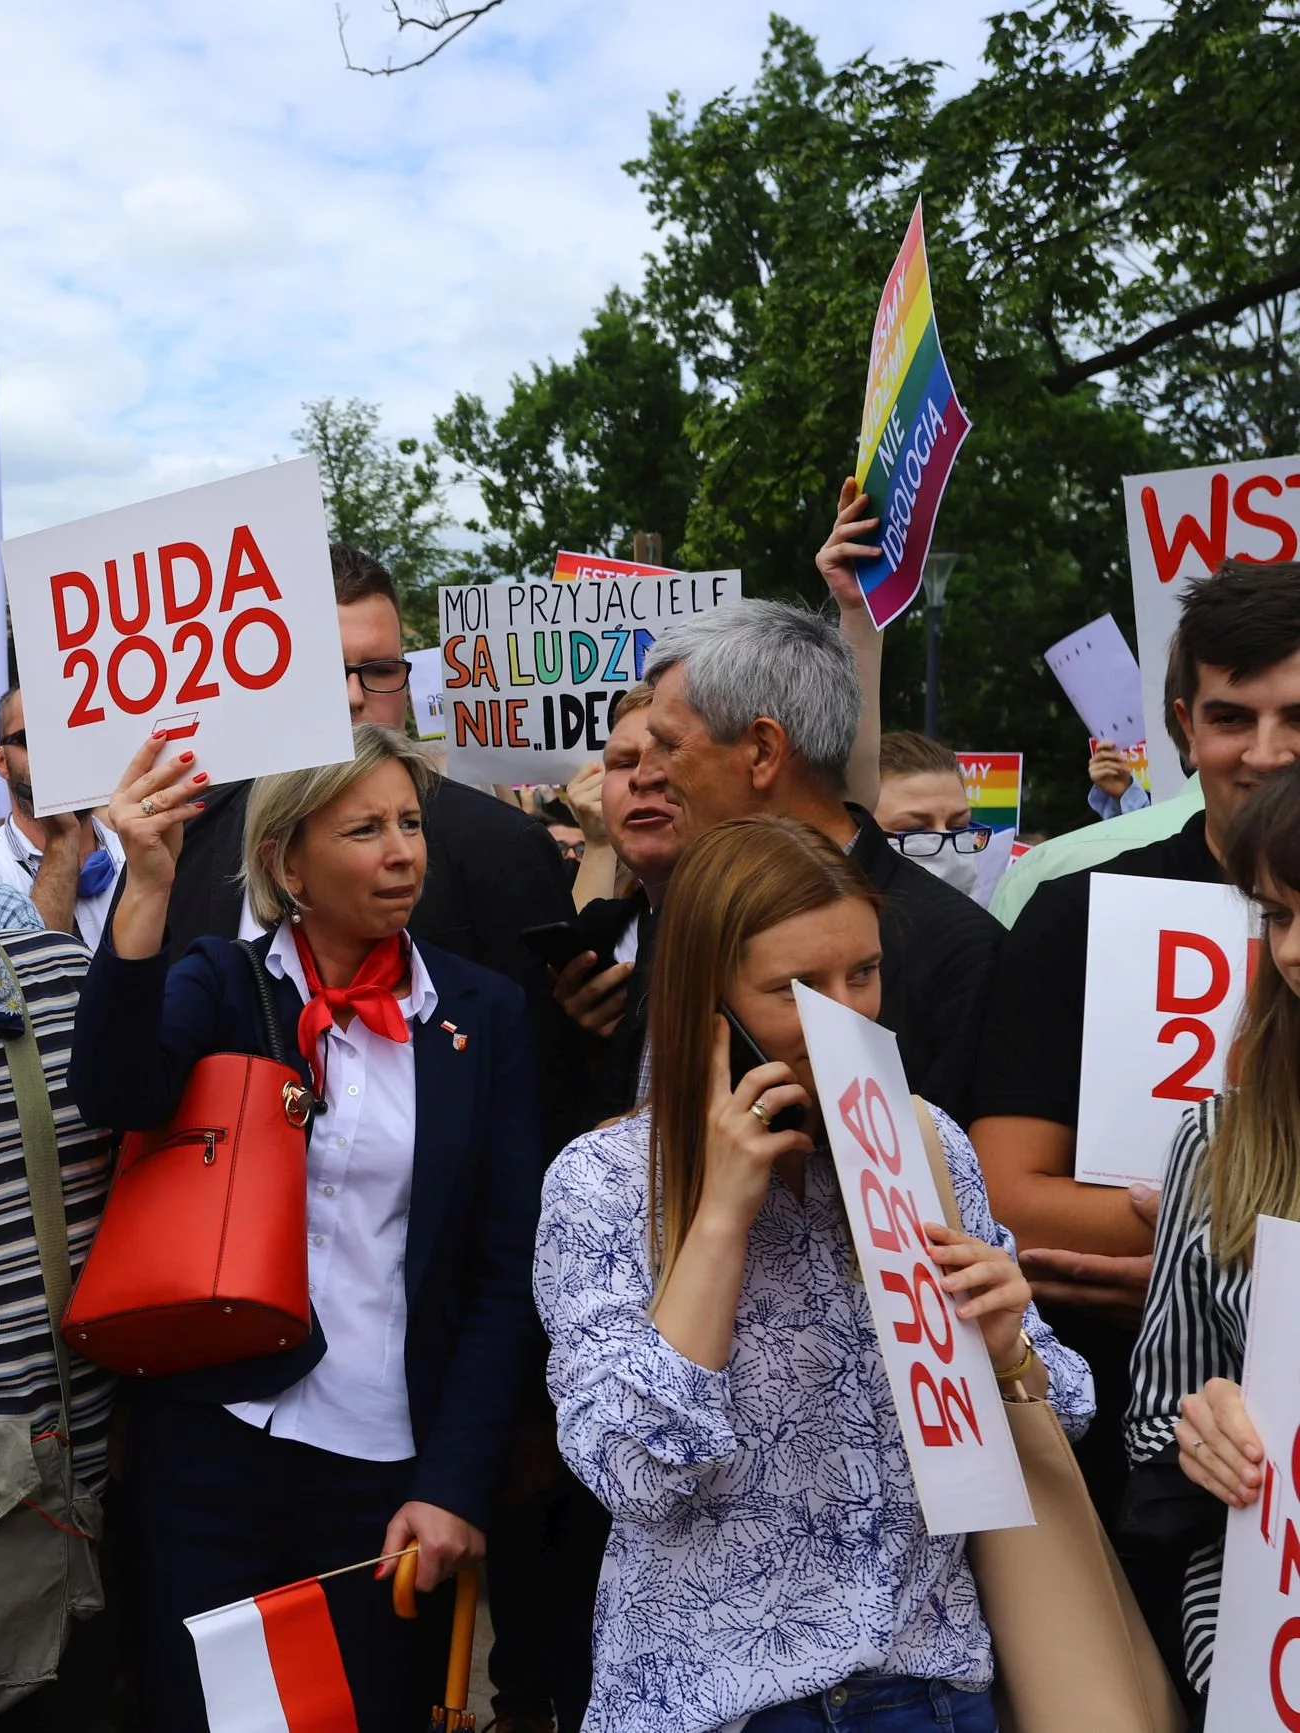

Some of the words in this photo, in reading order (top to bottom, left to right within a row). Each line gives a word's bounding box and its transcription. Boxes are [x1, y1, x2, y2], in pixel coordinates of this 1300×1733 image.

[877, 403, 906, 479] NIE
[880, 396, 948, 573] IDEOLOGIĄ
[50, 525, 282, 651] DUDA
[445, 587, 489, 634] MOI
[508, 577, 728, 626] PRZYJACIELE
[63, 607, 292, 728] 2020
[443, 634, 500, 692] SĄ
[453, 699, 531, 748] NIE
[838, 1076, 954, 1447] DUDA
[865, 1076, 984, 1447] 2020
